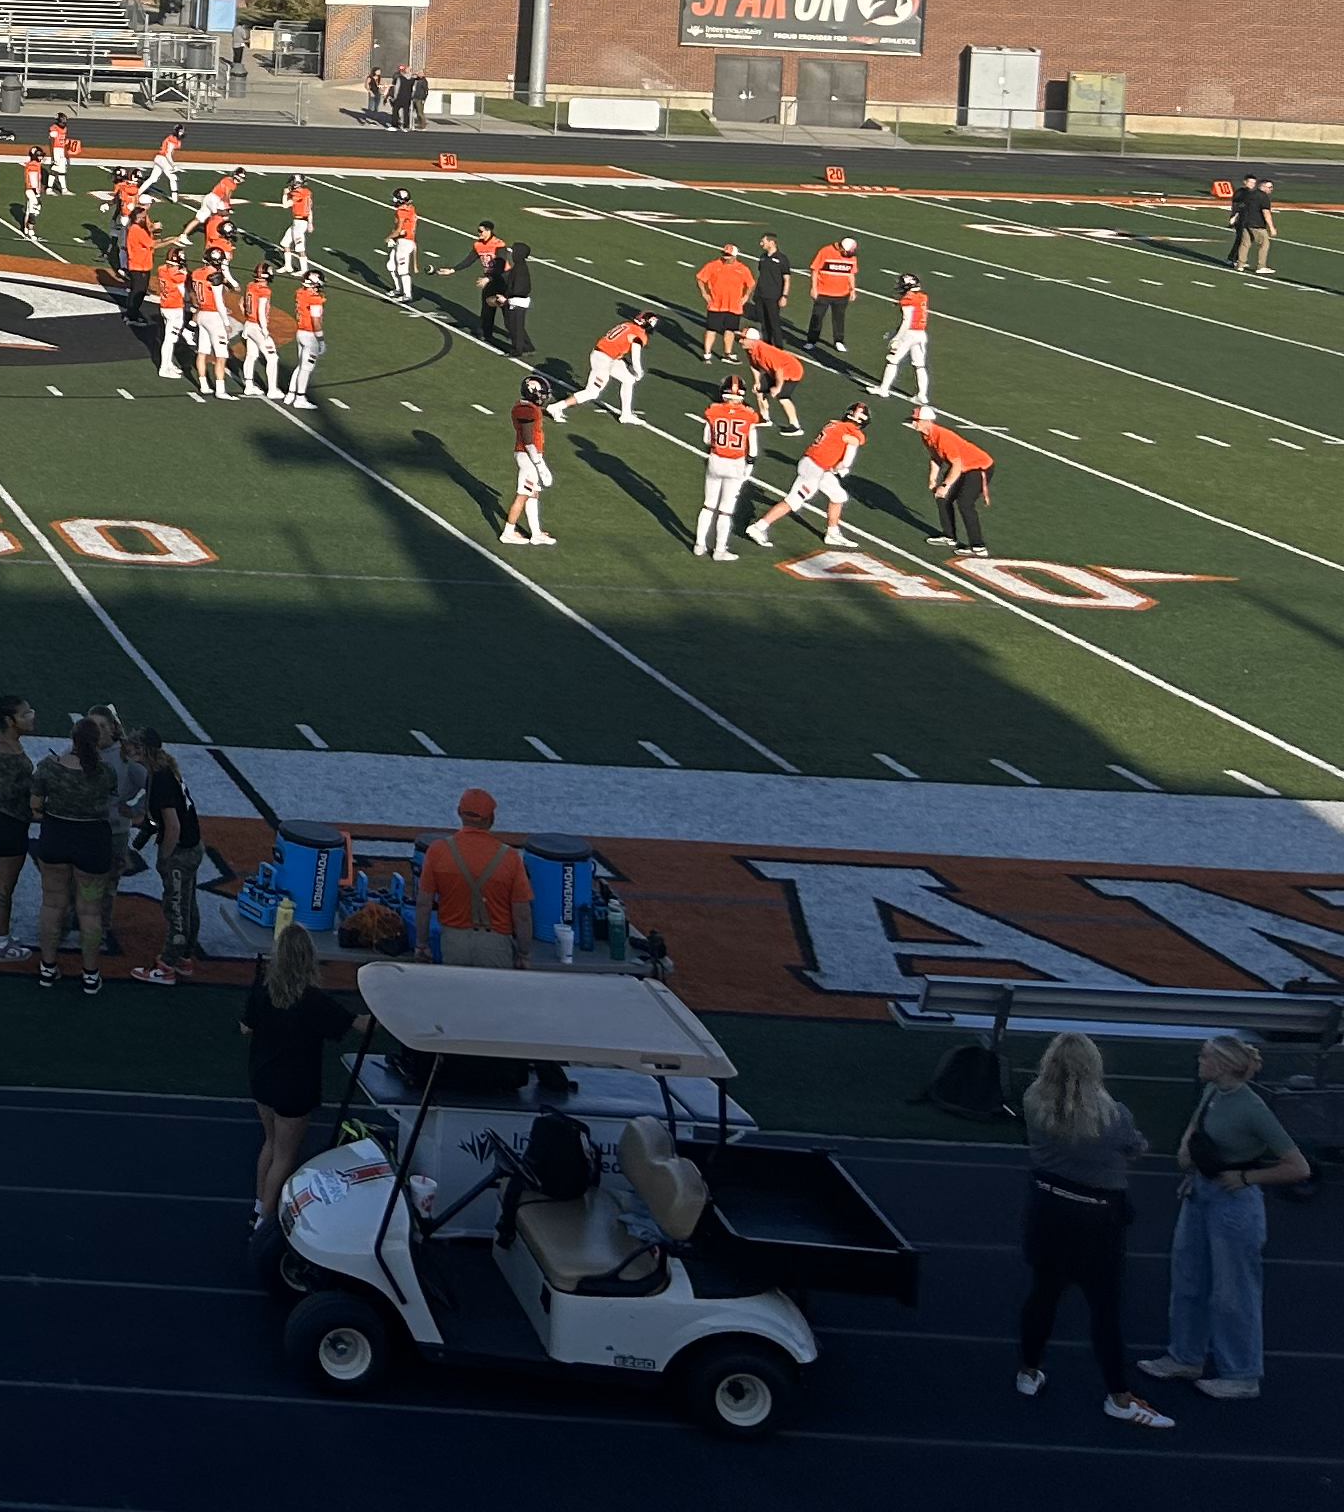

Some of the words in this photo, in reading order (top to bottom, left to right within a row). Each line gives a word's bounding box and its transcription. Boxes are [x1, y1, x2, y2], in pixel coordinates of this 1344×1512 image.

[441, 153, 457, 168] 30
[827, 168, 844, 181] 20
[1217, 182, 1232, 195] 10
[714, 419, 746, 450] 85
[775, 548, 1159, 611] 40
[312, 852, 329, 908] POWERADE
[562, 865, 574, 922] POWERADE
